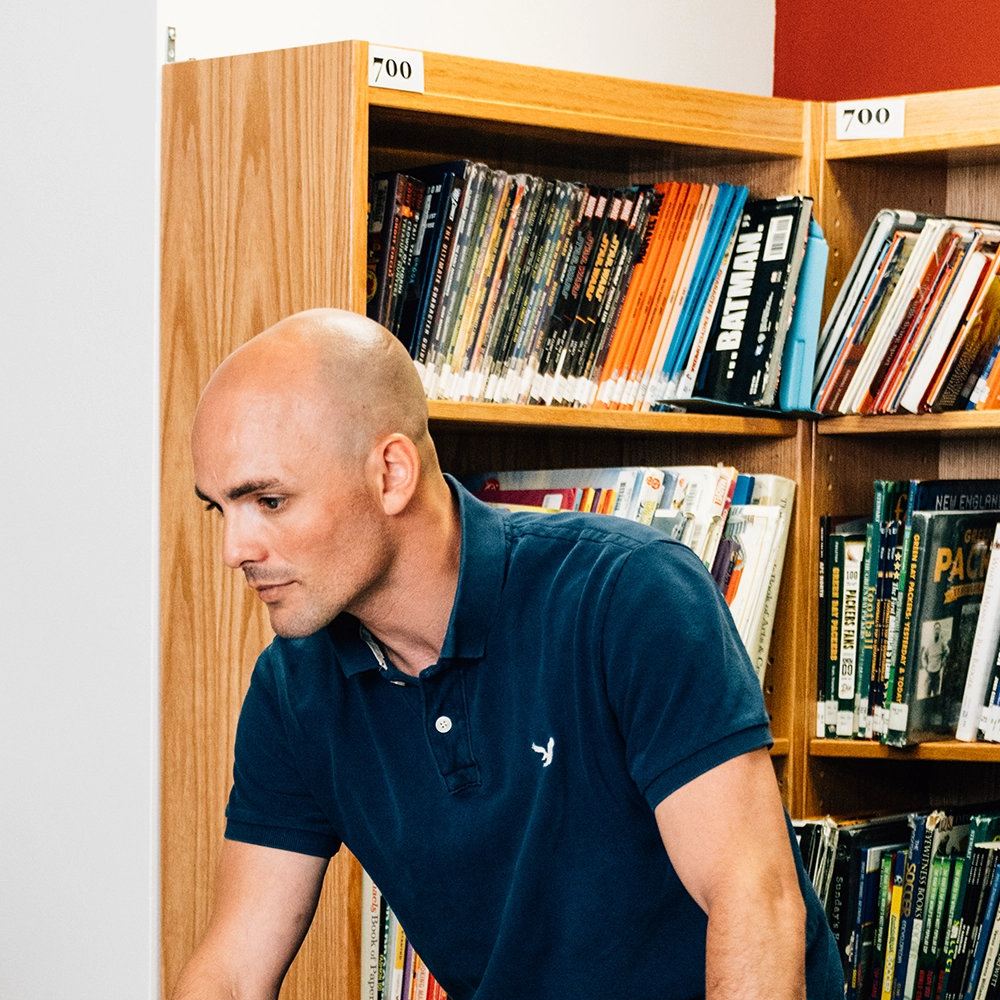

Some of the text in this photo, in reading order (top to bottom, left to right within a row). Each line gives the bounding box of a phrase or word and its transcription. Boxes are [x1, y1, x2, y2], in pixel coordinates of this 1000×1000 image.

[373, 56, 412, 83] 700
[843, 107, 890, 132] 700
[637, 193, 665, 263] MARVEL AGE
[392, 218, 407, 297] TREASURE HUNTERS
[401, 252, 407, 265] OF
[560, 237, 569, 256] WARS
[437, 243, 448, 283] ULTIMATE
[562, 230, 584, 299] STAR WARS
[572, 231, 593, 299] STAR WARS
[586, 233, 608, 301] STAR WARS
[596, 234, 620, 302] STAR WARS
[547, 281, 558, 307] DROIDS
[424, 286, 439, 335] CHARACTER
[690, 269, 722, 372] CHARACTER ENCYCLOPEDIA
[418, 338, 427, 362] GUIDE
[715, 476, 726, 505] MARVEL
[935, 495, 957, 511] NEW
[910, 533, 920, 562] GREEN
[830, 566, 841, 598] GREEN
[846, 570, 858, 580] 100
[862, 573, 870, 593] GREEN
[908, 563, 917, 579] BAY
[768, 573, 776, 600] Book
[817, 575, 825, 598] NORTH
[888, 581, 898, 615] The First
[905, 582, 915, 619] PACKERS:
[764, 604, 771, 614] of
[829, 600, 839, 617] BAY
[841, 590, 857, 650] PACKERS FANS
[864, 585, 877, 650] football
[760, 618, 769, 644] Arts
[859, 610, 868, 639] PACKERS
[829, 620, 840, 661] PACKERS
[901, 622, 910, 665] YESTERDAY
[842, 664, 853, 676] DO
[969, 658, 979, 689] BADGER
[894, 676, 904, 703] TODAY
[966, 829, 975, 860] STEWART
[914, 829, 933, 919] EYEWITNESS BOOKS
[832, 876, 843, 929] Sunday's
[902, 863, 916, 917] SOCCER
[370, 915, 379, 946] Book
[992, 930, 1000, 946] Venus
[370, 951, 377, 961] of
[982, 958, 992, 975] Serena
[884, 955, 894, 992] SOCCER
[976, 977, 986, 1000] Williams
